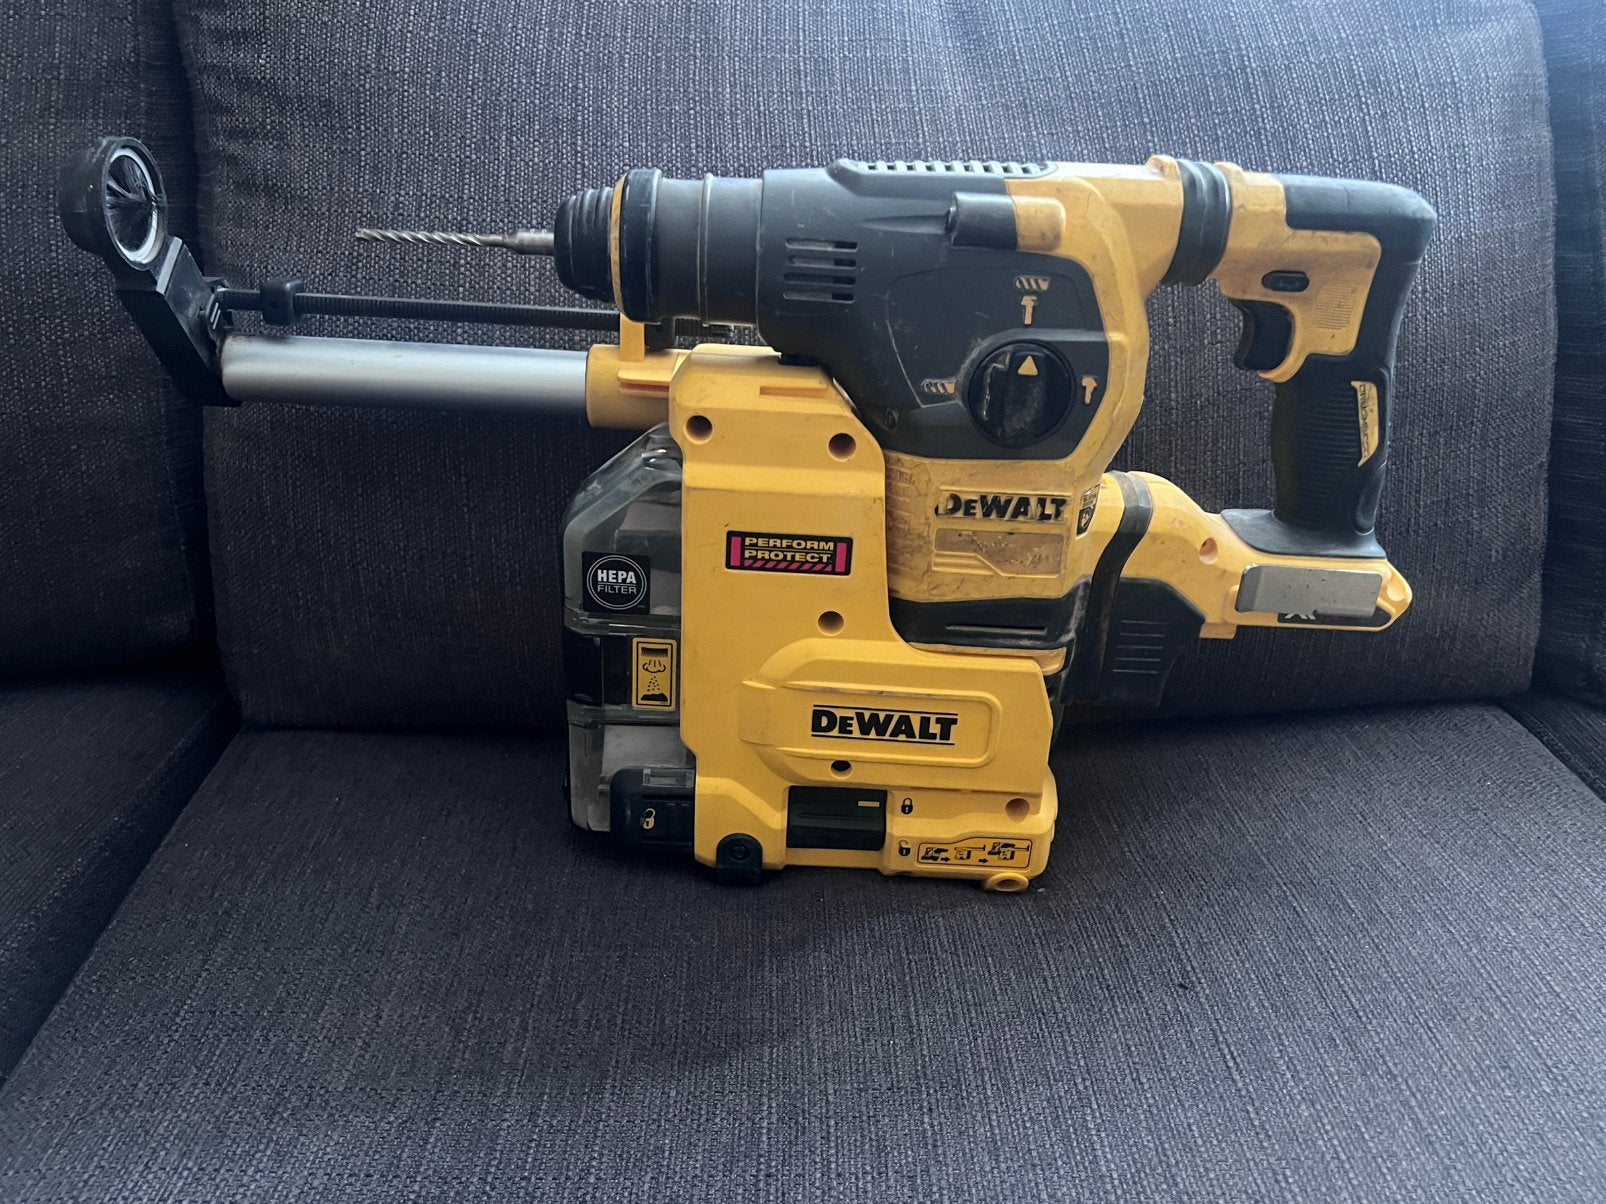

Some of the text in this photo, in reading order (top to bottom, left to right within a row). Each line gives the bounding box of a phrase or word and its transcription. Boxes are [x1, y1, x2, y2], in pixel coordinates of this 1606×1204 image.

[744, 537, 835, 551] PERFORM
[744, 549, 832, 563] PROTECT
[597, 569, 637, 584] HEPA
[597, 584, 637, 595] FILTER
